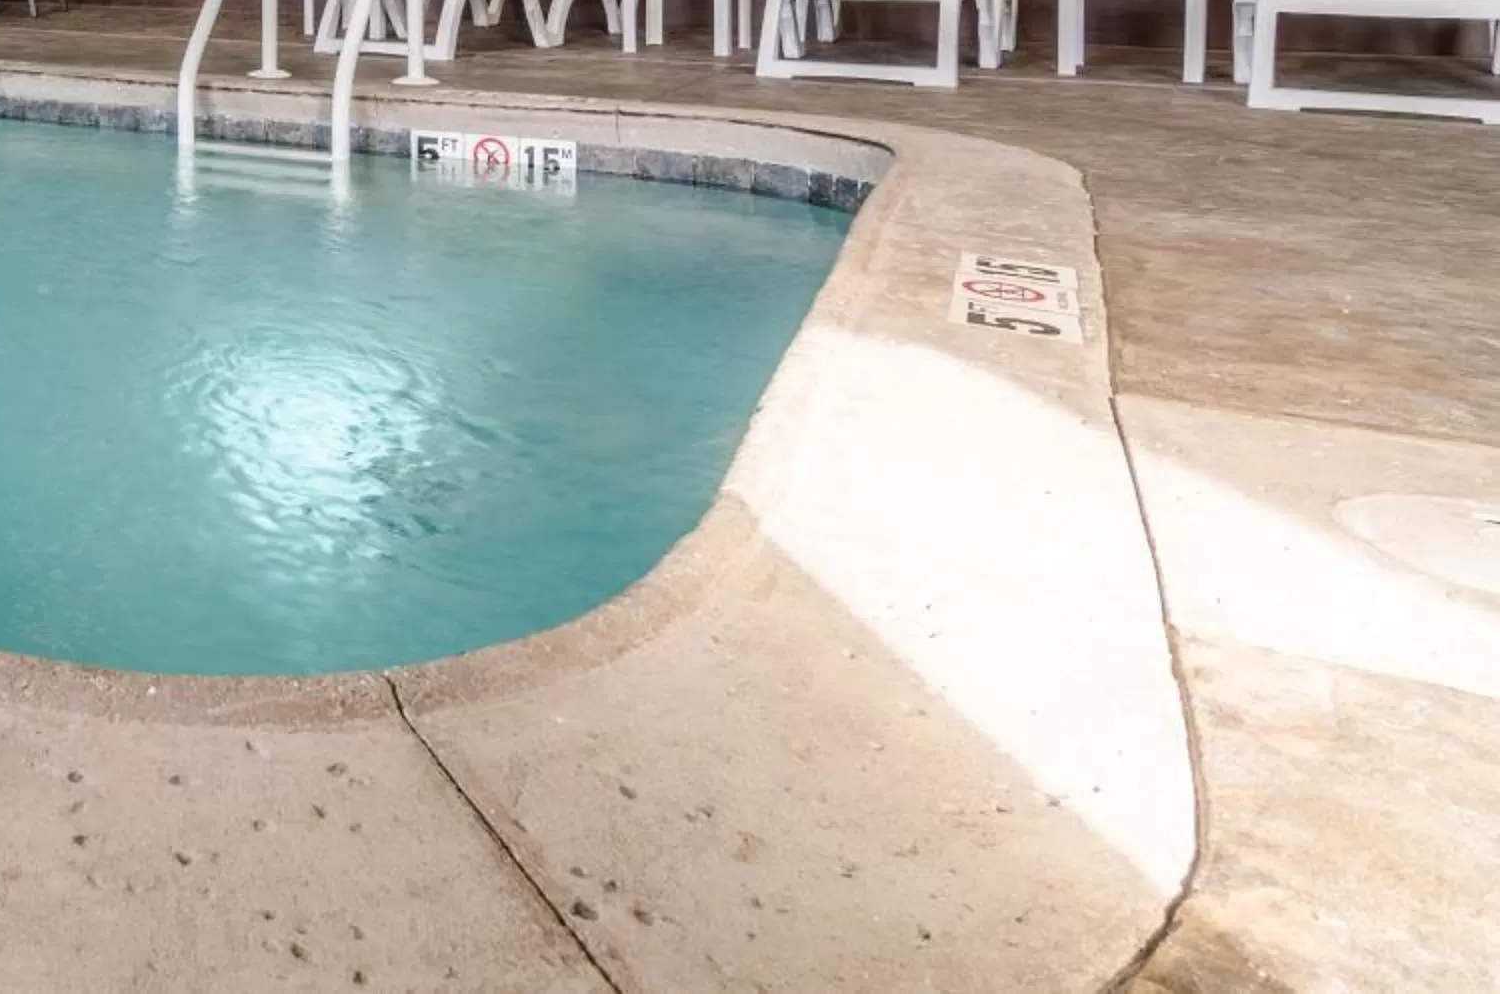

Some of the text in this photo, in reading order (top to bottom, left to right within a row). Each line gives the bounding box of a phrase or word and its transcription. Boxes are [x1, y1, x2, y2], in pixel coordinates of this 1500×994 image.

[417, 136, 458, 160] 5 FT
[561, 149, 573, 159] M
[966, 312, 1061, 335] 5
